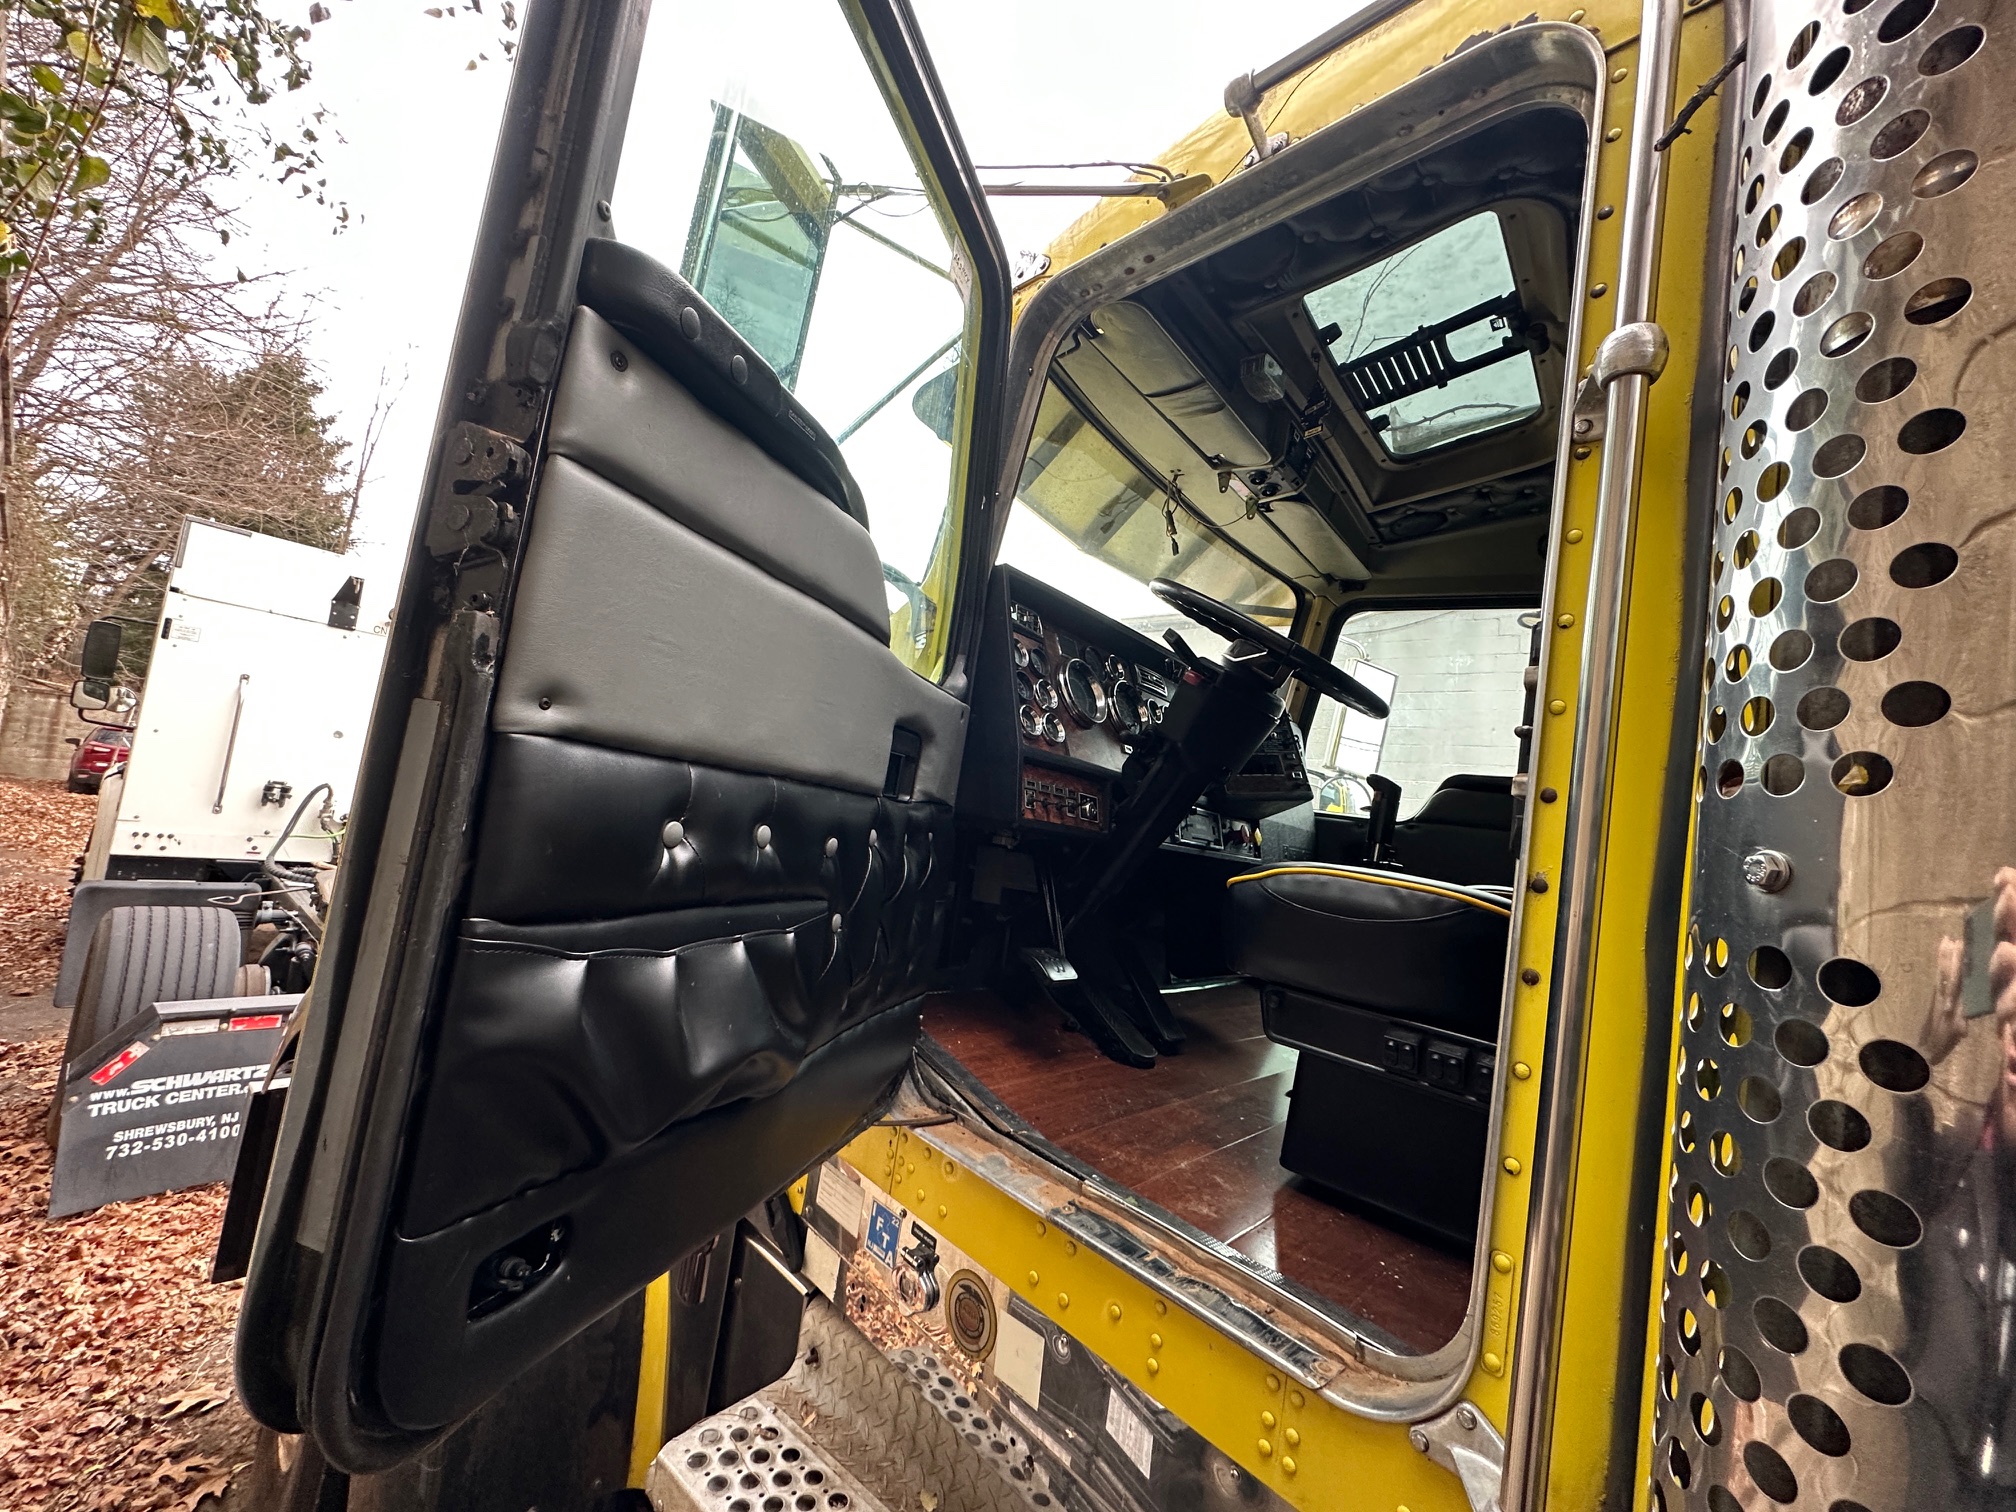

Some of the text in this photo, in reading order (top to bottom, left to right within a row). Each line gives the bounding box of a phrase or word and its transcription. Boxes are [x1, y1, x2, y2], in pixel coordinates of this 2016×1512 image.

[87, 1094, 161, 1118] TRUCK
[105, 1123, 241, 1161] 732-530-4100
[112, 1111, 240, 1143] SHREWSBURY, NJ
